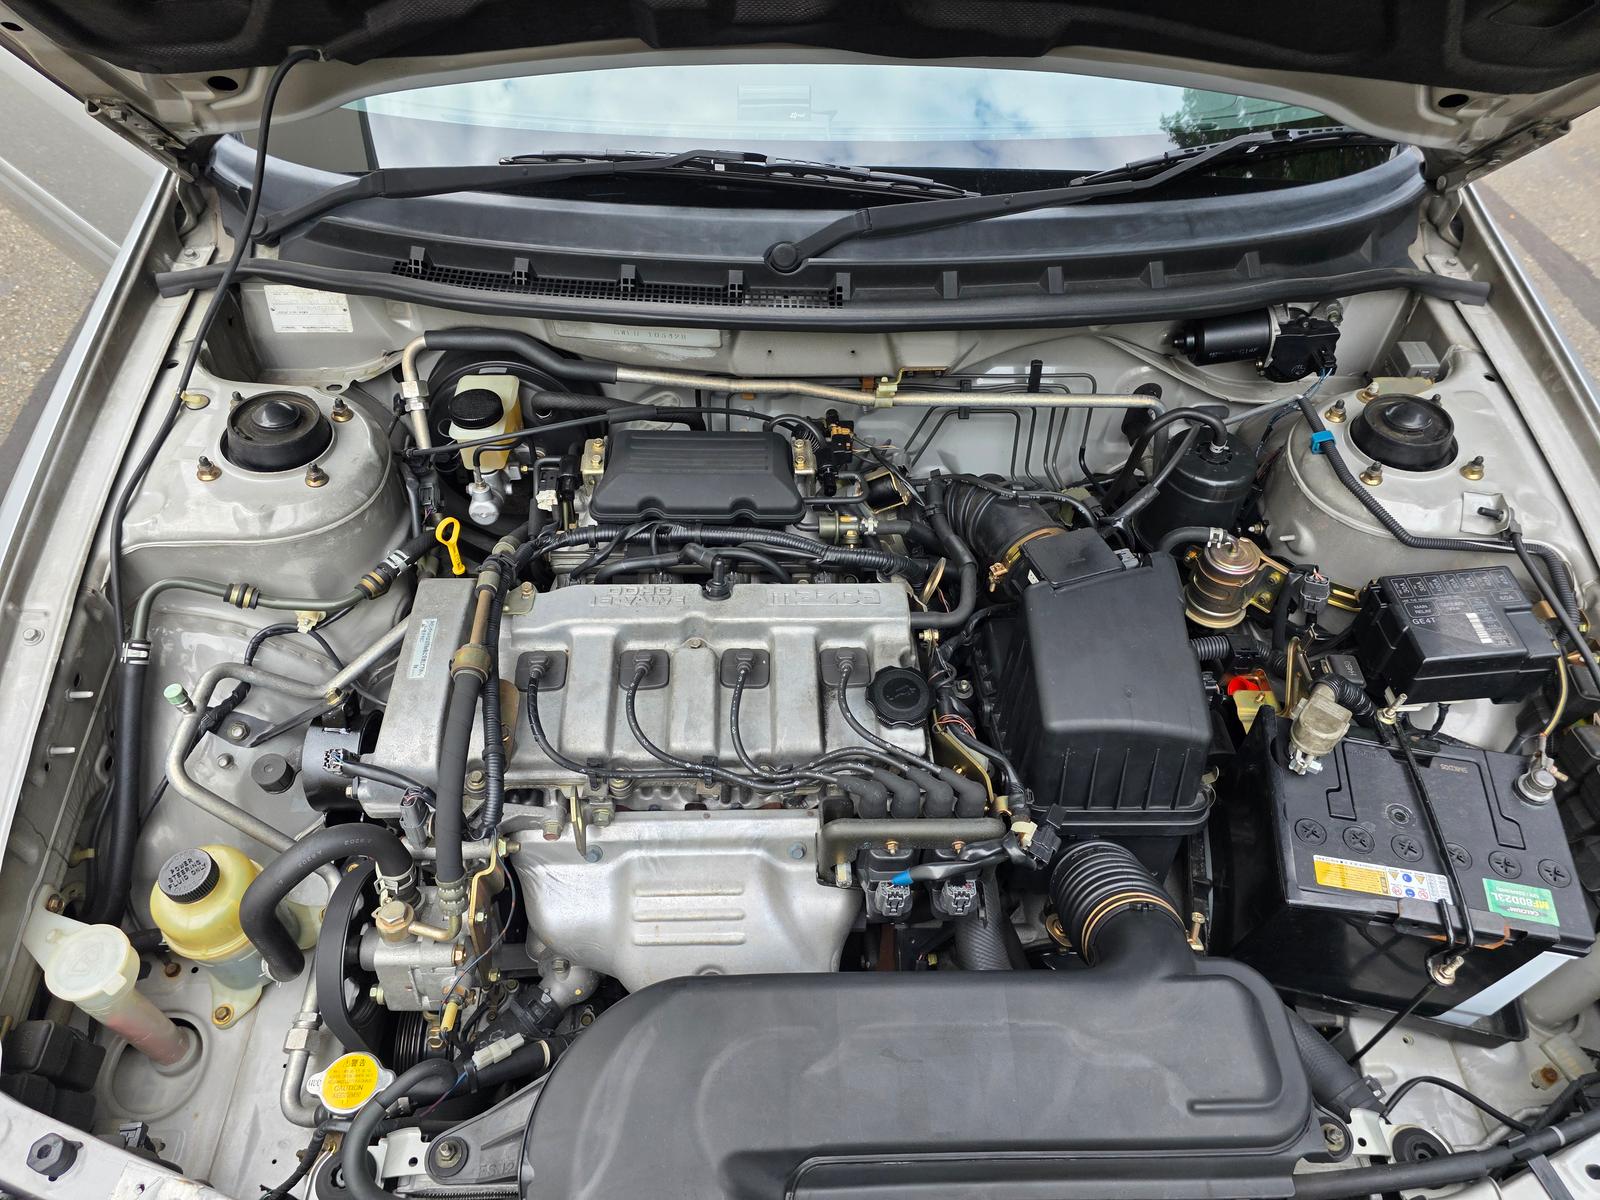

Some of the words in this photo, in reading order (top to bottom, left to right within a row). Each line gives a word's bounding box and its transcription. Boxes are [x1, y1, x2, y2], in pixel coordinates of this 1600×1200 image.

[1412, 617, 1437, 625] GE4T
[168, 860, 202, 884] STEERING
[168, 874, 189, 889] FLUID
[190, 862, 207, 876] ONLY
[170, 858, 193, 875] POWER
